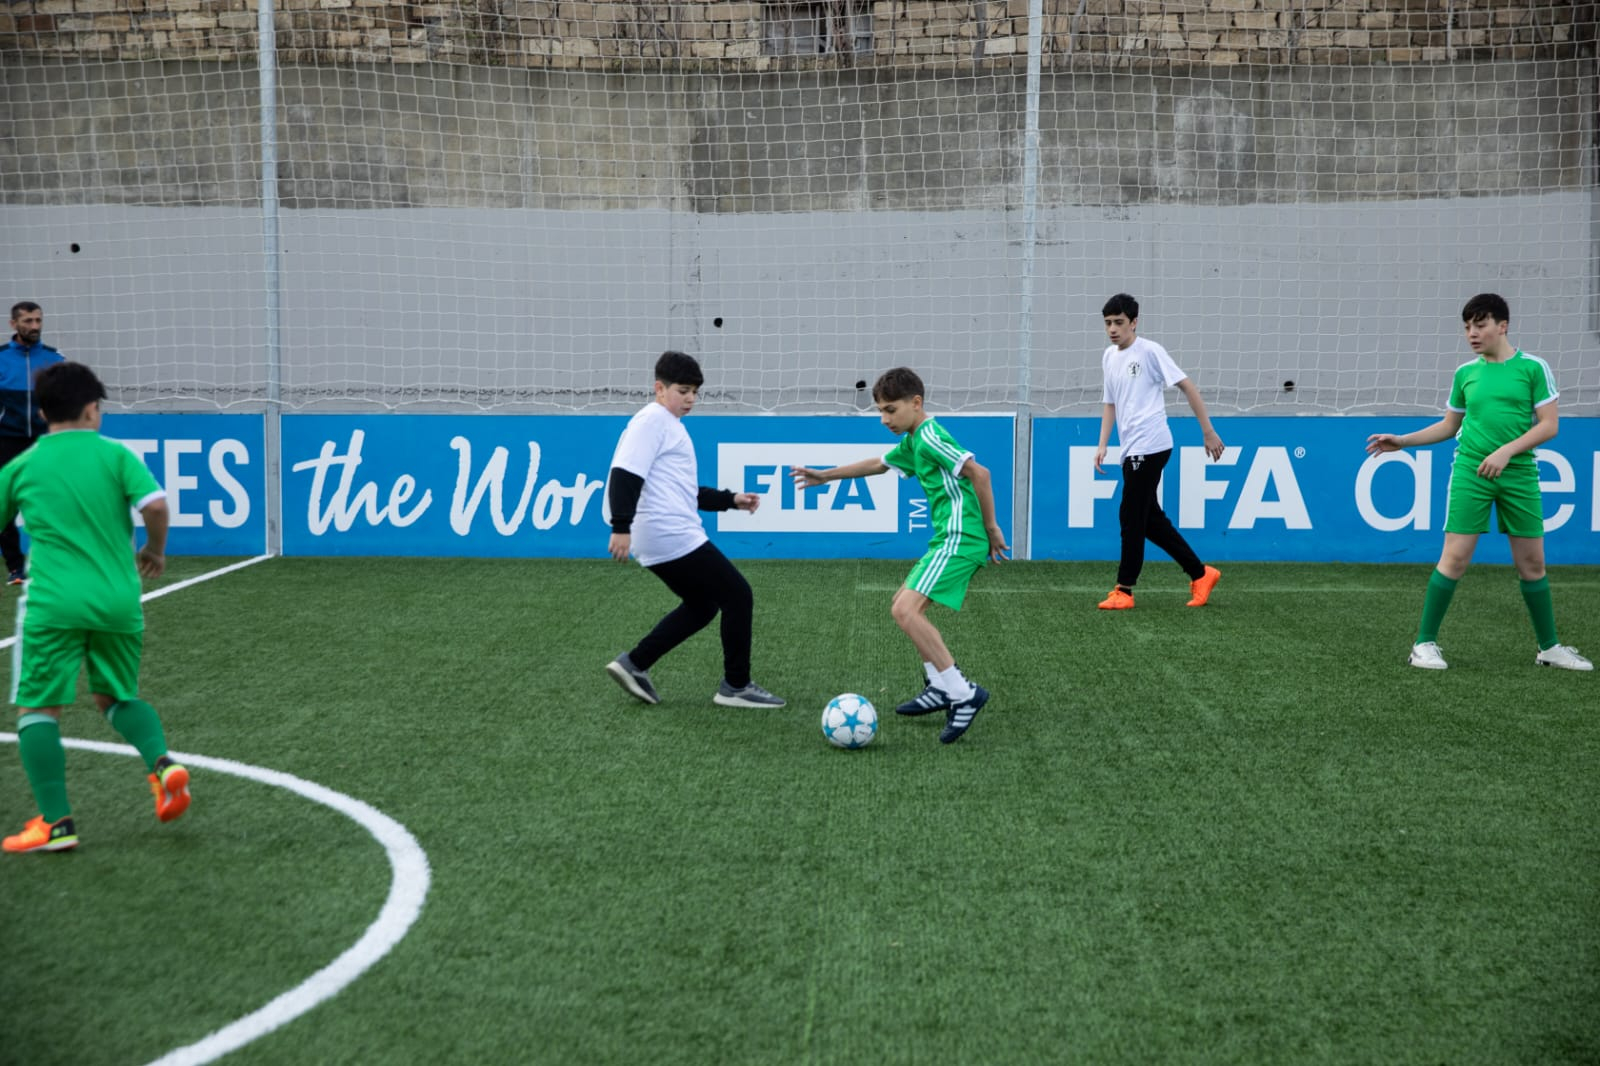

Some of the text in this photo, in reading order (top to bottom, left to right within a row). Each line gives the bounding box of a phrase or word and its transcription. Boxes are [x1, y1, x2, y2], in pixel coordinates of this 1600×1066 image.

[117, 438, 250, 528] TES
[292, 429, 622, 536] the Wor
[908, 498, 928, 533] TM
